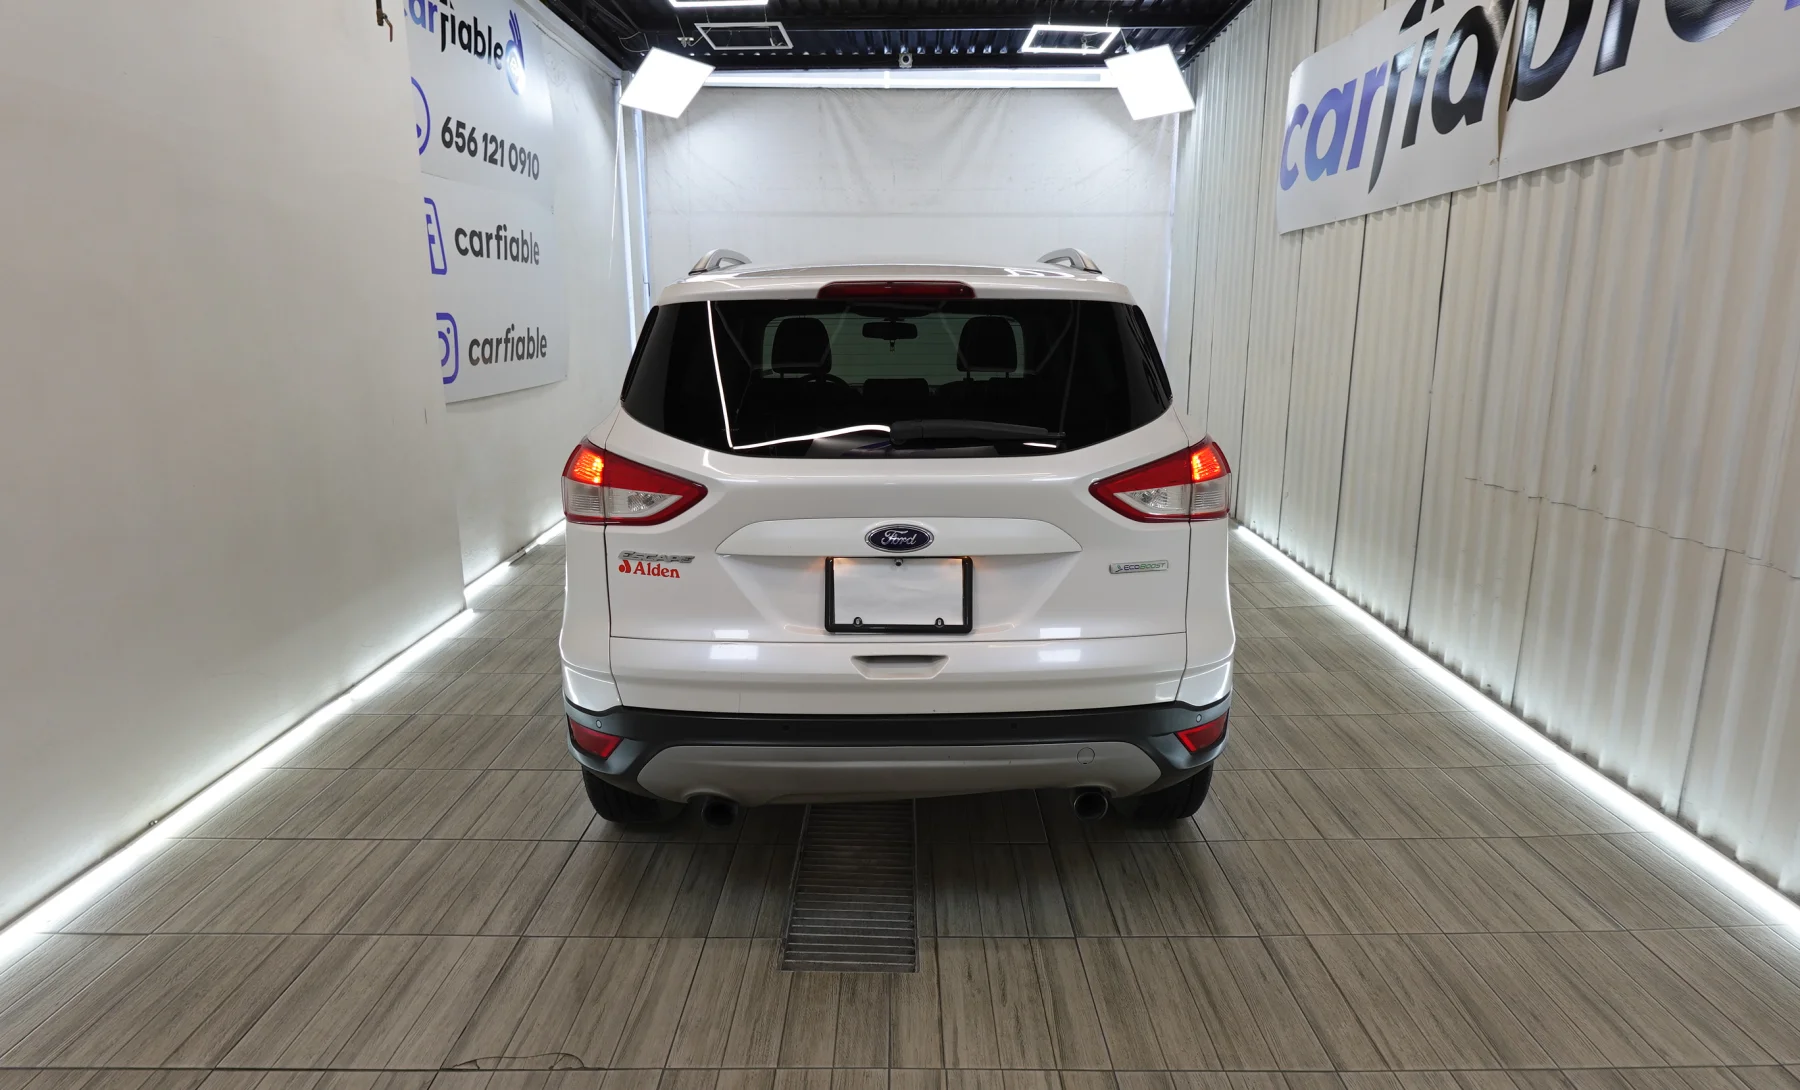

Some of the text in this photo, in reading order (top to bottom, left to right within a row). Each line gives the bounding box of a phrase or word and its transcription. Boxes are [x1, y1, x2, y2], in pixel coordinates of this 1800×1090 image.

[403, 0, 504, 70] arfiable
[441, 116, 540, 181] 656 121 0910
[454, 224, 540, 265] carfiable
[468, 323, 547, 366] carfiable
[881, 529, 917, 545] Ford
[633, 561, 680, 578] Alden
